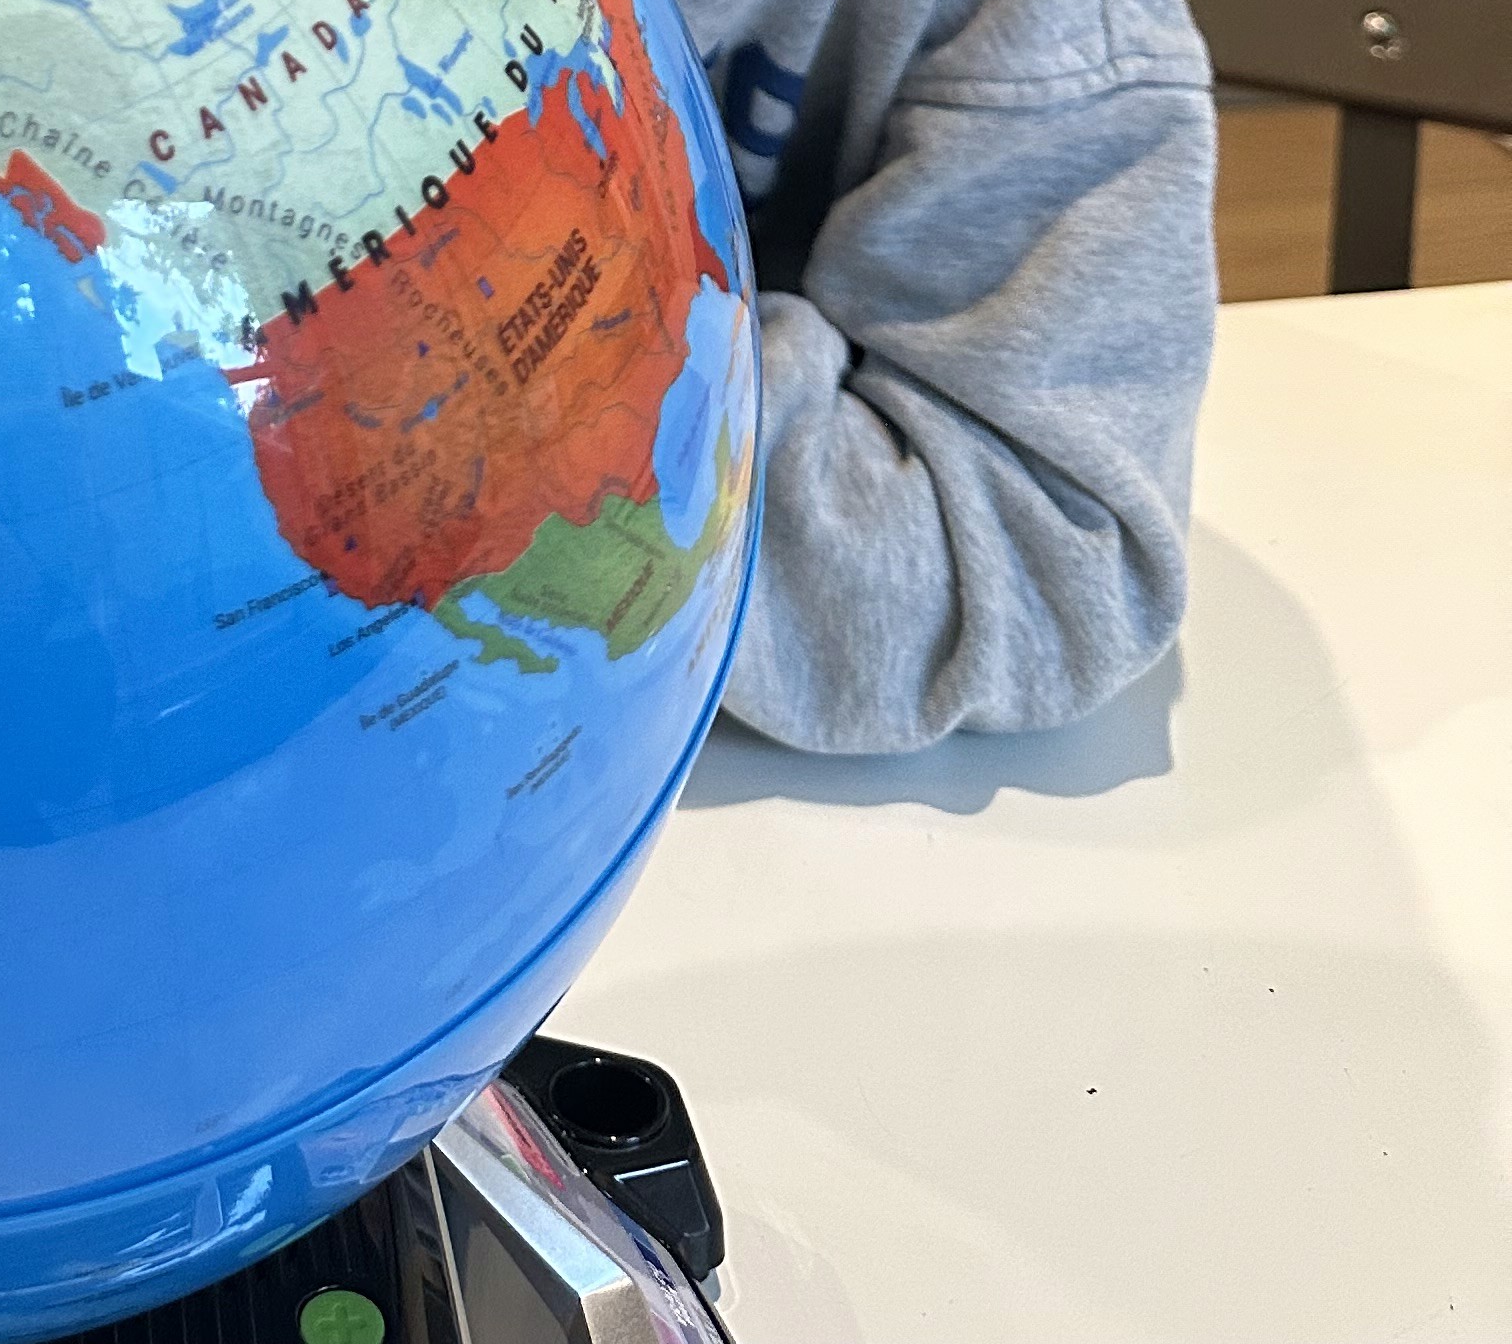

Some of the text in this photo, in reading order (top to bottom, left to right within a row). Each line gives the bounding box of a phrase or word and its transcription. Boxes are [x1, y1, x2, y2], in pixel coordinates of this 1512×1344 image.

[240, 109, 500, 356] AMÉRIQUE
[504, 22, 545, 93] DU
[203, 184, 367, 261] Montagnes
[214, 574, 321, 630] San Francisco
[327, 634, 356, 658] Los
